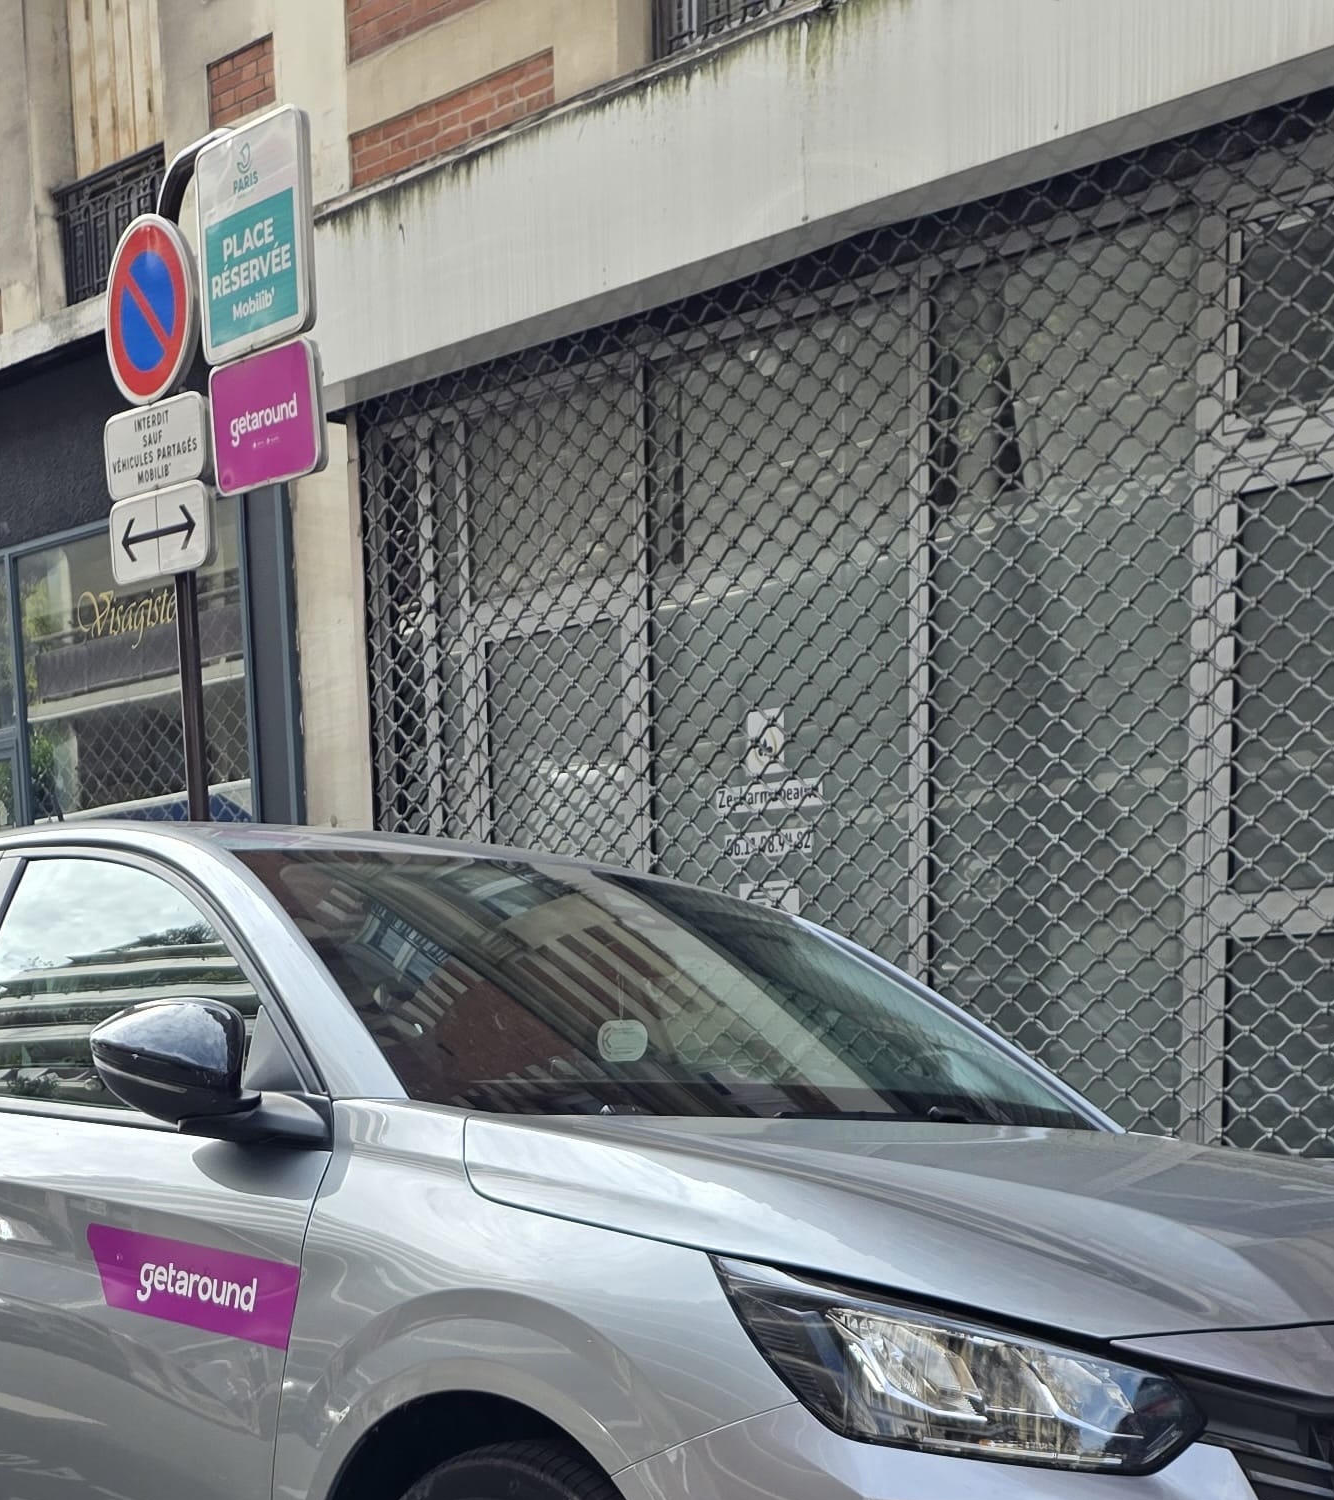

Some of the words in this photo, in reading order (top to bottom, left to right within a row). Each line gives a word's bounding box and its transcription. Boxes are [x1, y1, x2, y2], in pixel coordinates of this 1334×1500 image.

[233, 170, 259, 195] PARIS
[222, 217, 275, 263] PLACE
[211, 241, 292, 300] RÉSERVÉE
[232, 286, 275, 321] Mobilib'
[134, 410, 169, 432] INTERDIT
[142, 430, 163, 448] SAUF
[230, 391, 298, 448] getaround
[112, 450, 154, 474] VÉHICULES
[157, 436, 198, 461] PARTAGÉS
[78, 588, 177, 649] Visagiste
[136, 1262, 258, 1313] getaround
